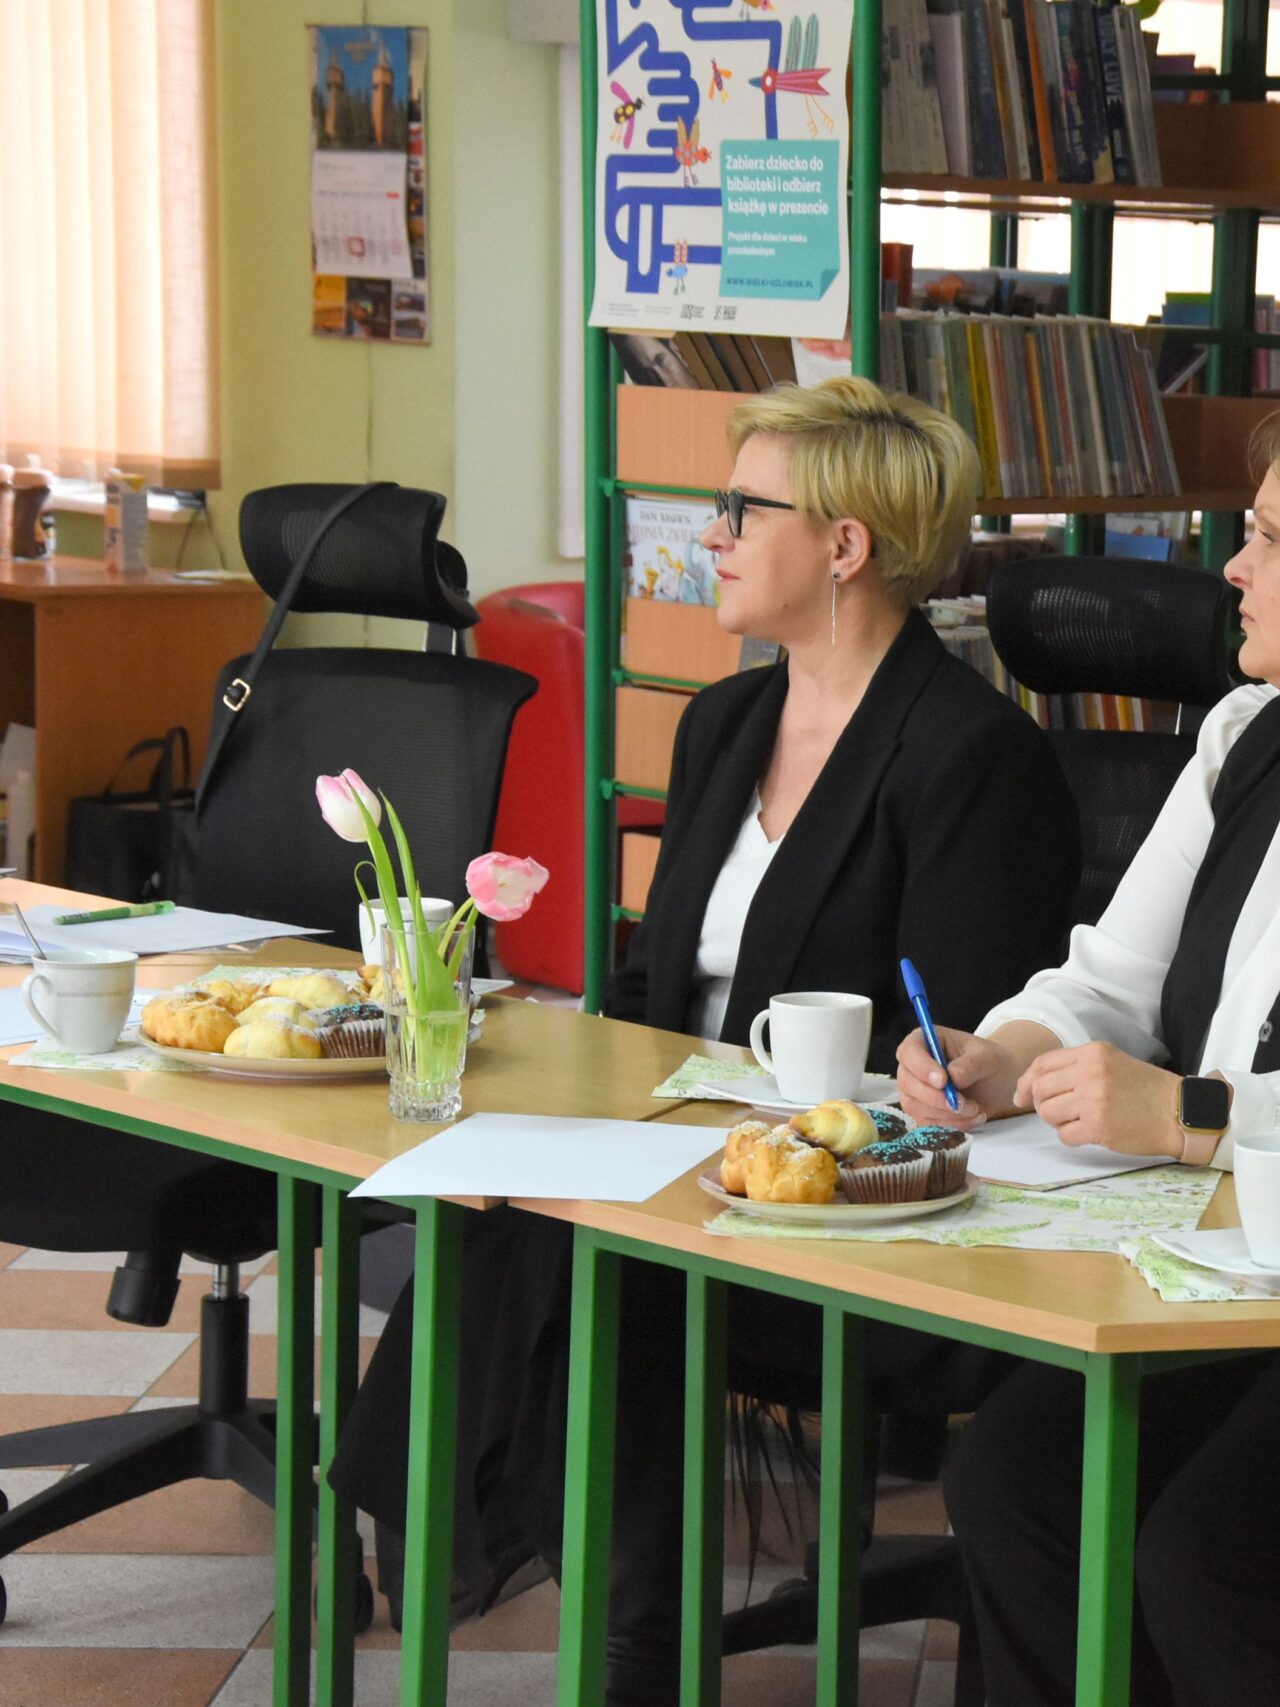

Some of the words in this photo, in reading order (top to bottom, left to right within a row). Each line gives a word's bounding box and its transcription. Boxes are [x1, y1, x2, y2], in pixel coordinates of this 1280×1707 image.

[1104, 62, 1121, 106] LOVE
[726, 155, 765, 171] Zabierz
[766, 155, 808, 171] dziecko
[810, 155, 824, 172] do
[726, 176, 777, 192] biblioteki
[782, 177, 821, 193] odbierz
[727, 198, 767, 216] książkę
[768, 202, 778, 214] w
[779, 199, 829, 217] prezencie
[727, 231, 751, 243] Projekt
[639, 510, 657, 521] DAN
[660, 512, 692, 525] BROWN
